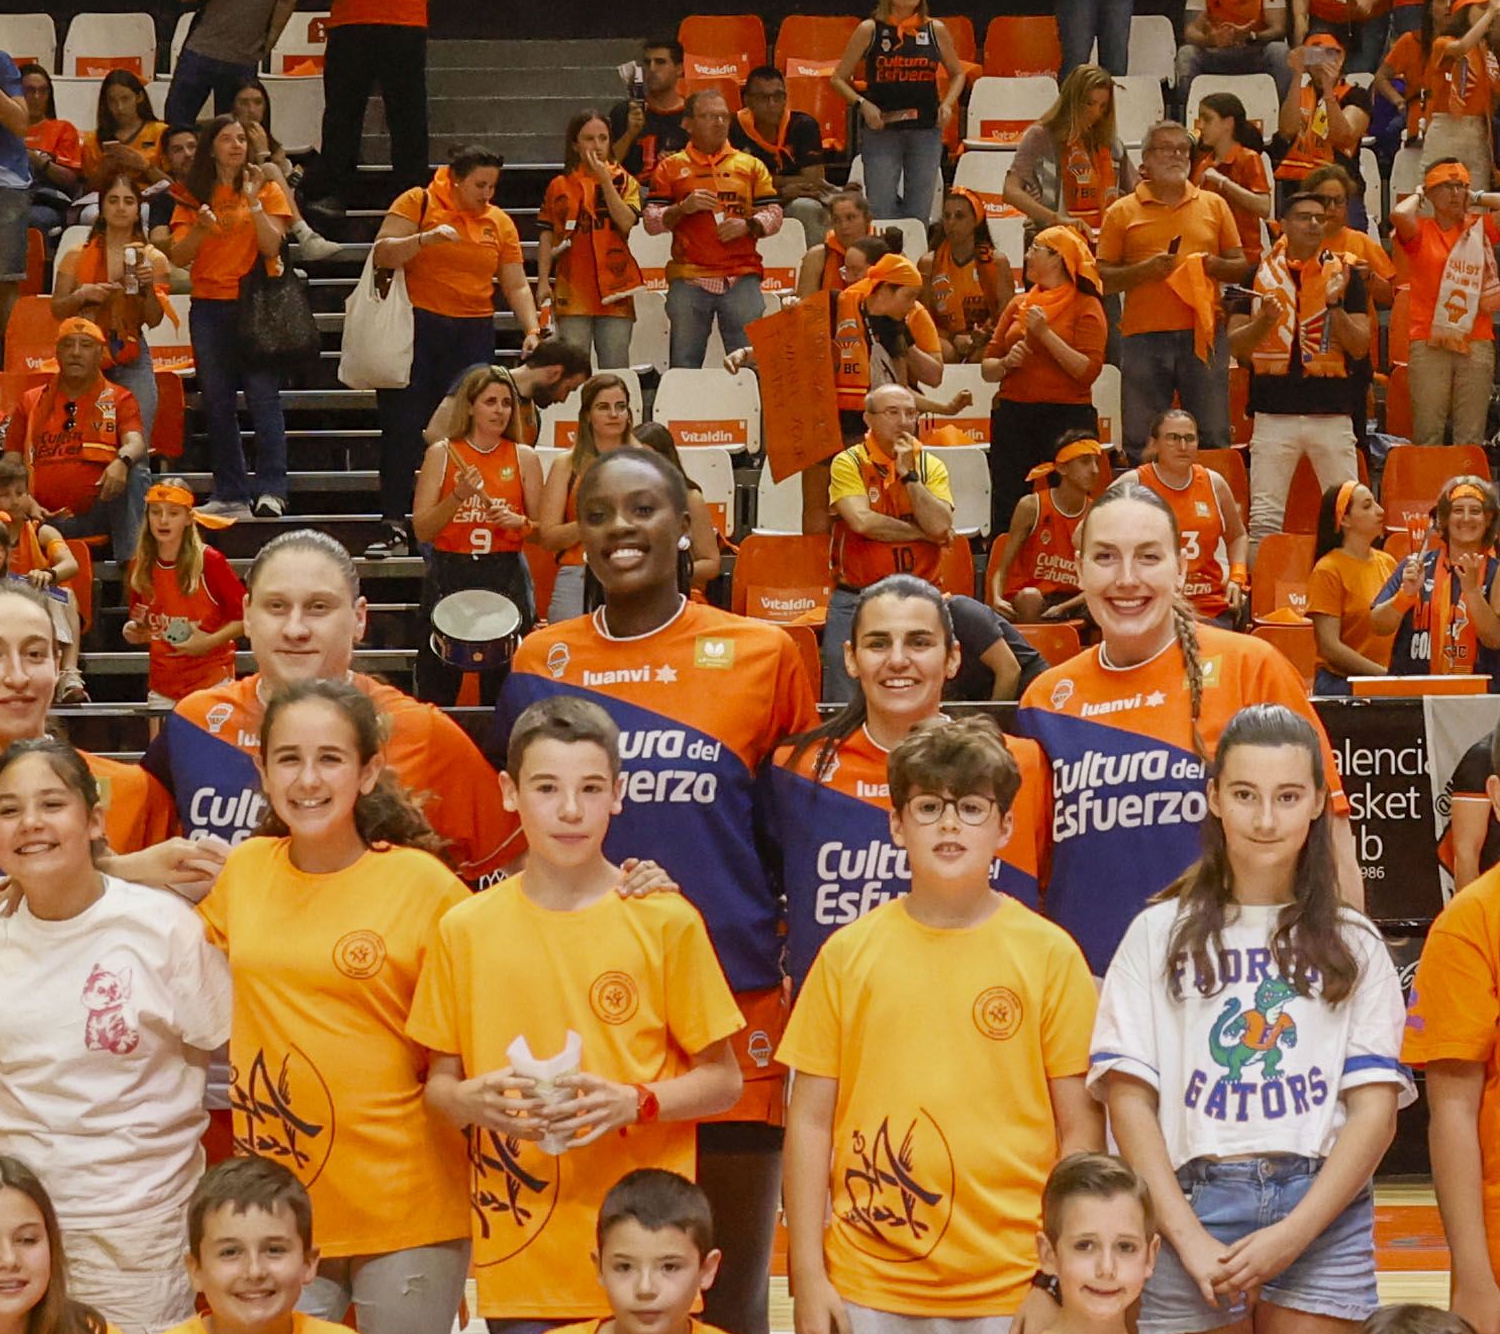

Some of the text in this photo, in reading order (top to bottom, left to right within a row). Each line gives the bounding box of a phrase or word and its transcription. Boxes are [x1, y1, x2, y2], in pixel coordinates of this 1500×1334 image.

[693, 62, 737, 76] Vitaldin
[875, 57, 929, 70] Cultura
[678, 428, 733, 443] Vitaldin
[469, 528, 492, 554] 9
[892, 547, 915, 572] 10
[1183, 582, 1212, 596] erzo
[760, 596, 815, 611] Vitaldin
[582, 664, 651, 687] luanvi
[1081, 693, 1141, 718] luanvi
[688, 739, 721, 762] del
[1052, 749, 1168, 798] Cultura
[618, 770, 716, 803] erzo
[856, 779, 889, 797] lua
[189, 787, 269, 829] Cult
[1346, 784, 1420, 820] sket
[1053, 787, 1205, 843] Esfuerzo
[1358, 867, 1384, 879] 986
[816, 881, 909, 925] Esfu
[1184, 1067, 1328, 1122] GATORS
